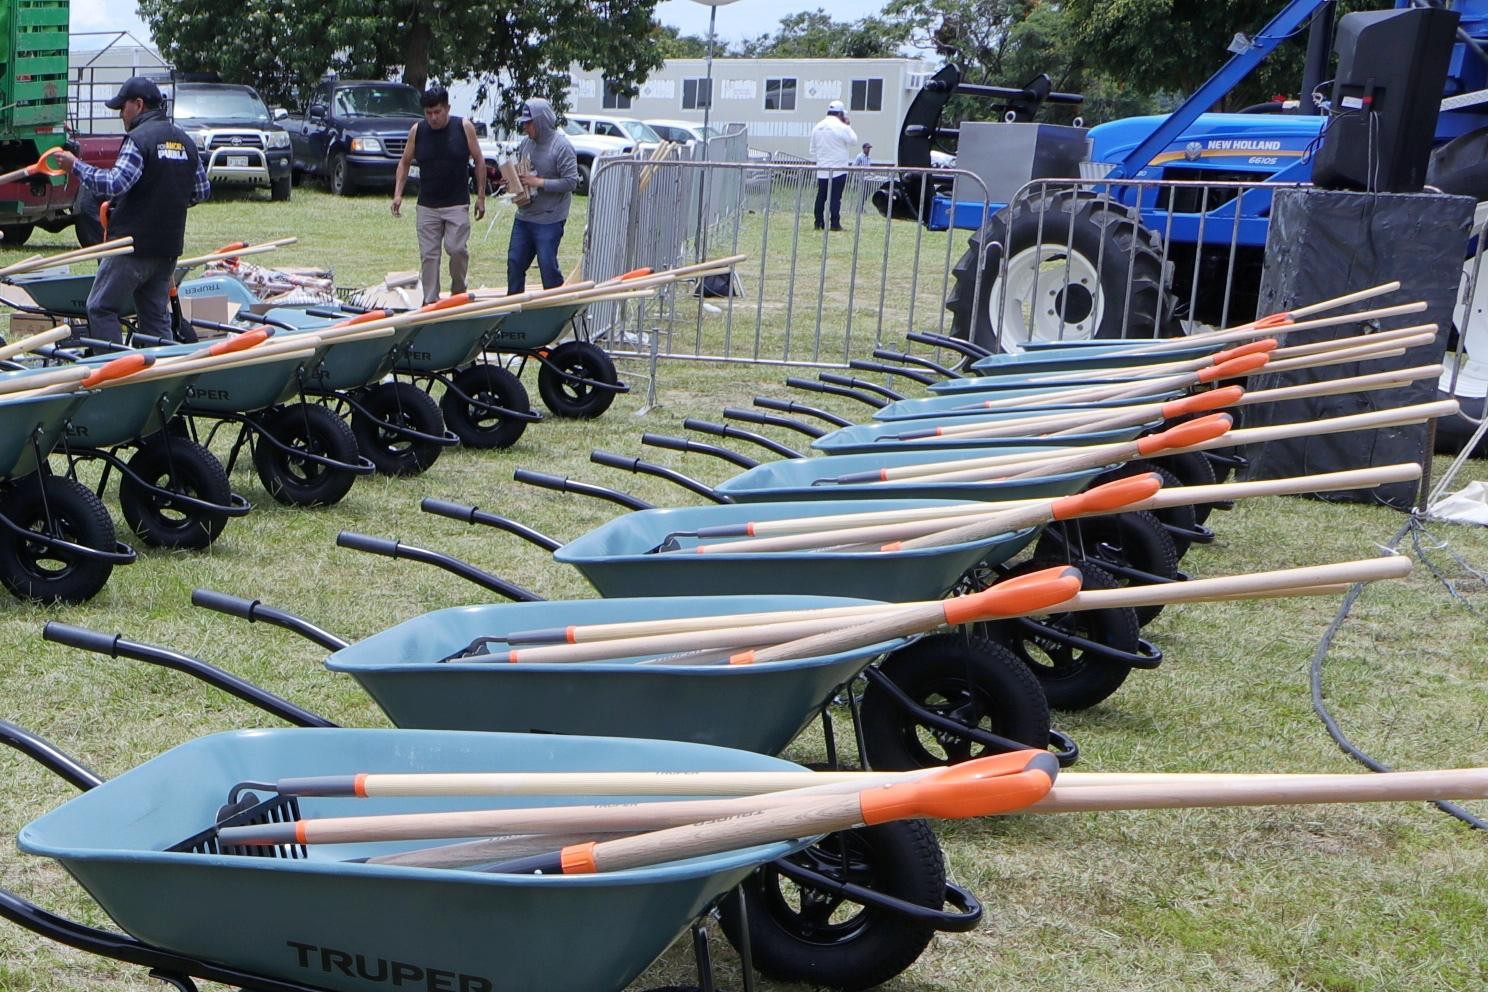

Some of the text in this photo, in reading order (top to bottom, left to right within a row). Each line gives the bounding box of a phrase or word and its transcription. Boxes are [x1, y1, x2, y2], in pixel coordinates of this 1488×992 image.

[1208, 140, 1281, 150] NEW HOLLAND
[184, 283, 221, 295] TRUPER
